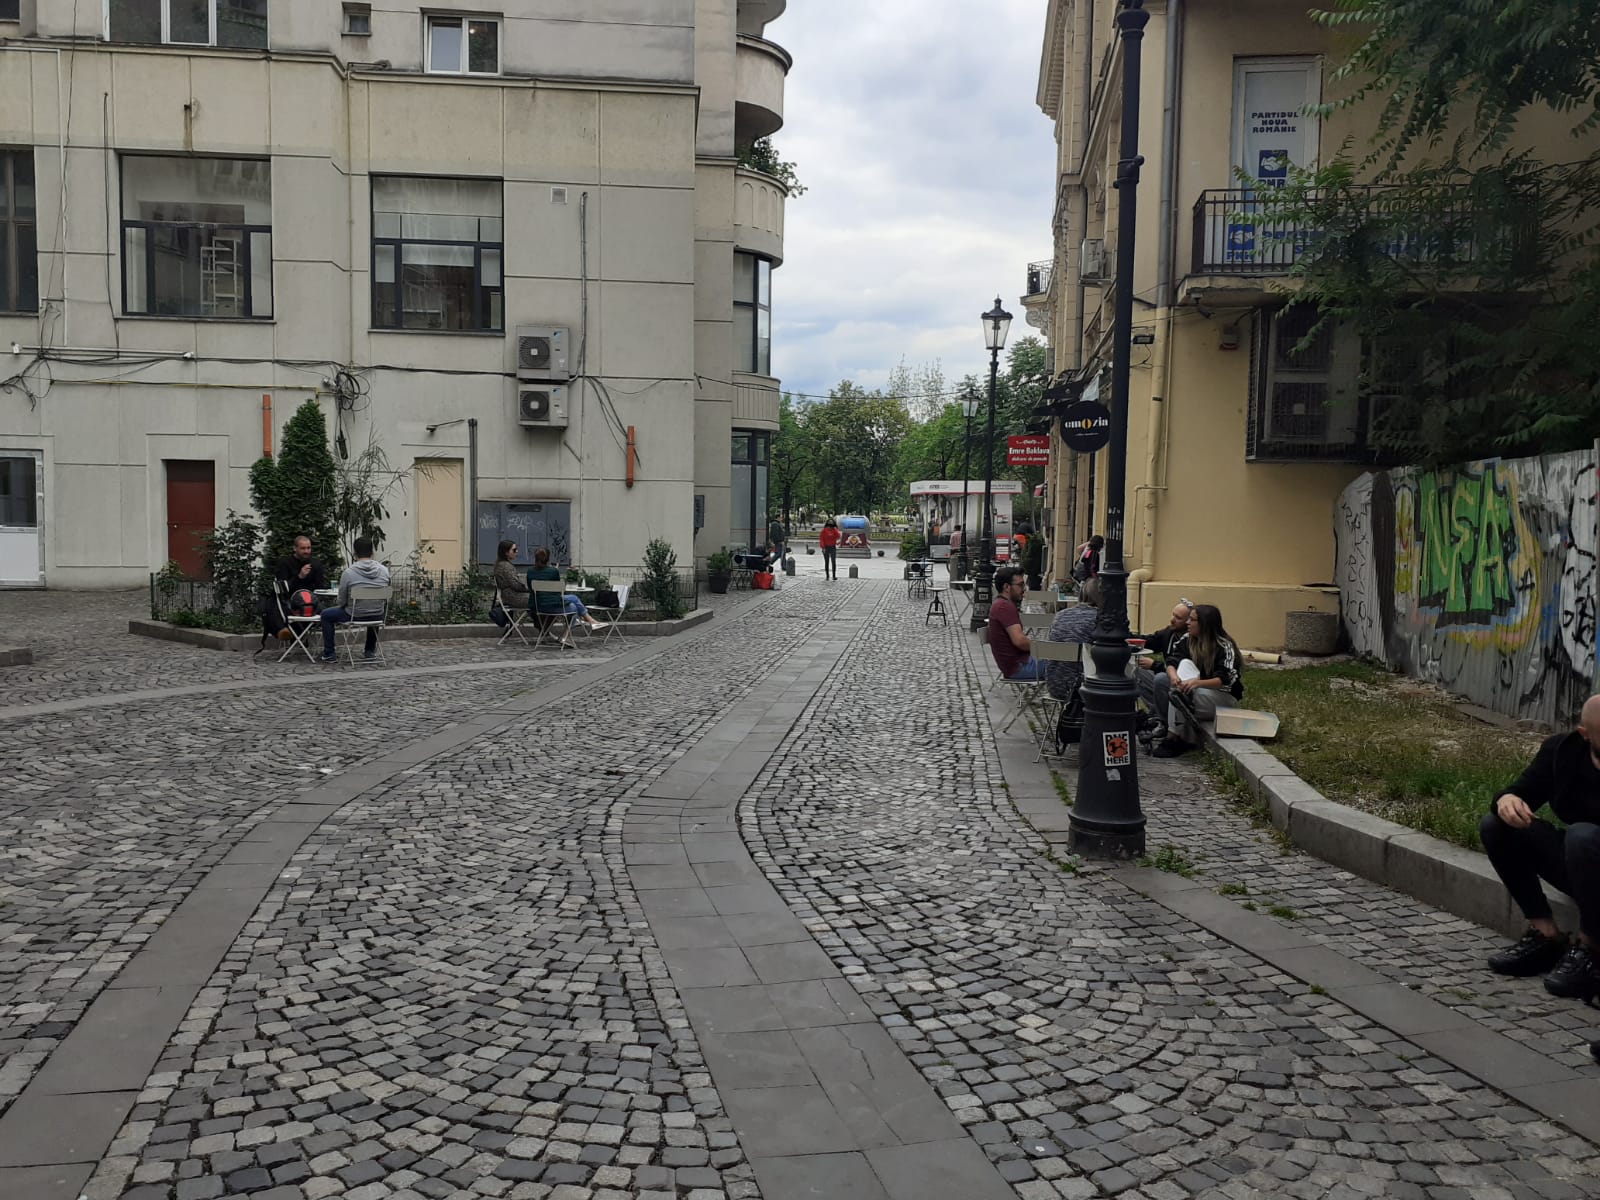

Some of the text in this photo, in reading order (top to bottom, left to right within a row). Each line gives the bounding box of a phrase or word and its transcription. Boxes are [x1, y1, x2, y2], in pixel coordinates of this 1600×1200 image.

[1009, 446, 1050, 455] Emre Baklava
[1106, 756, 1128, 764] HERE
